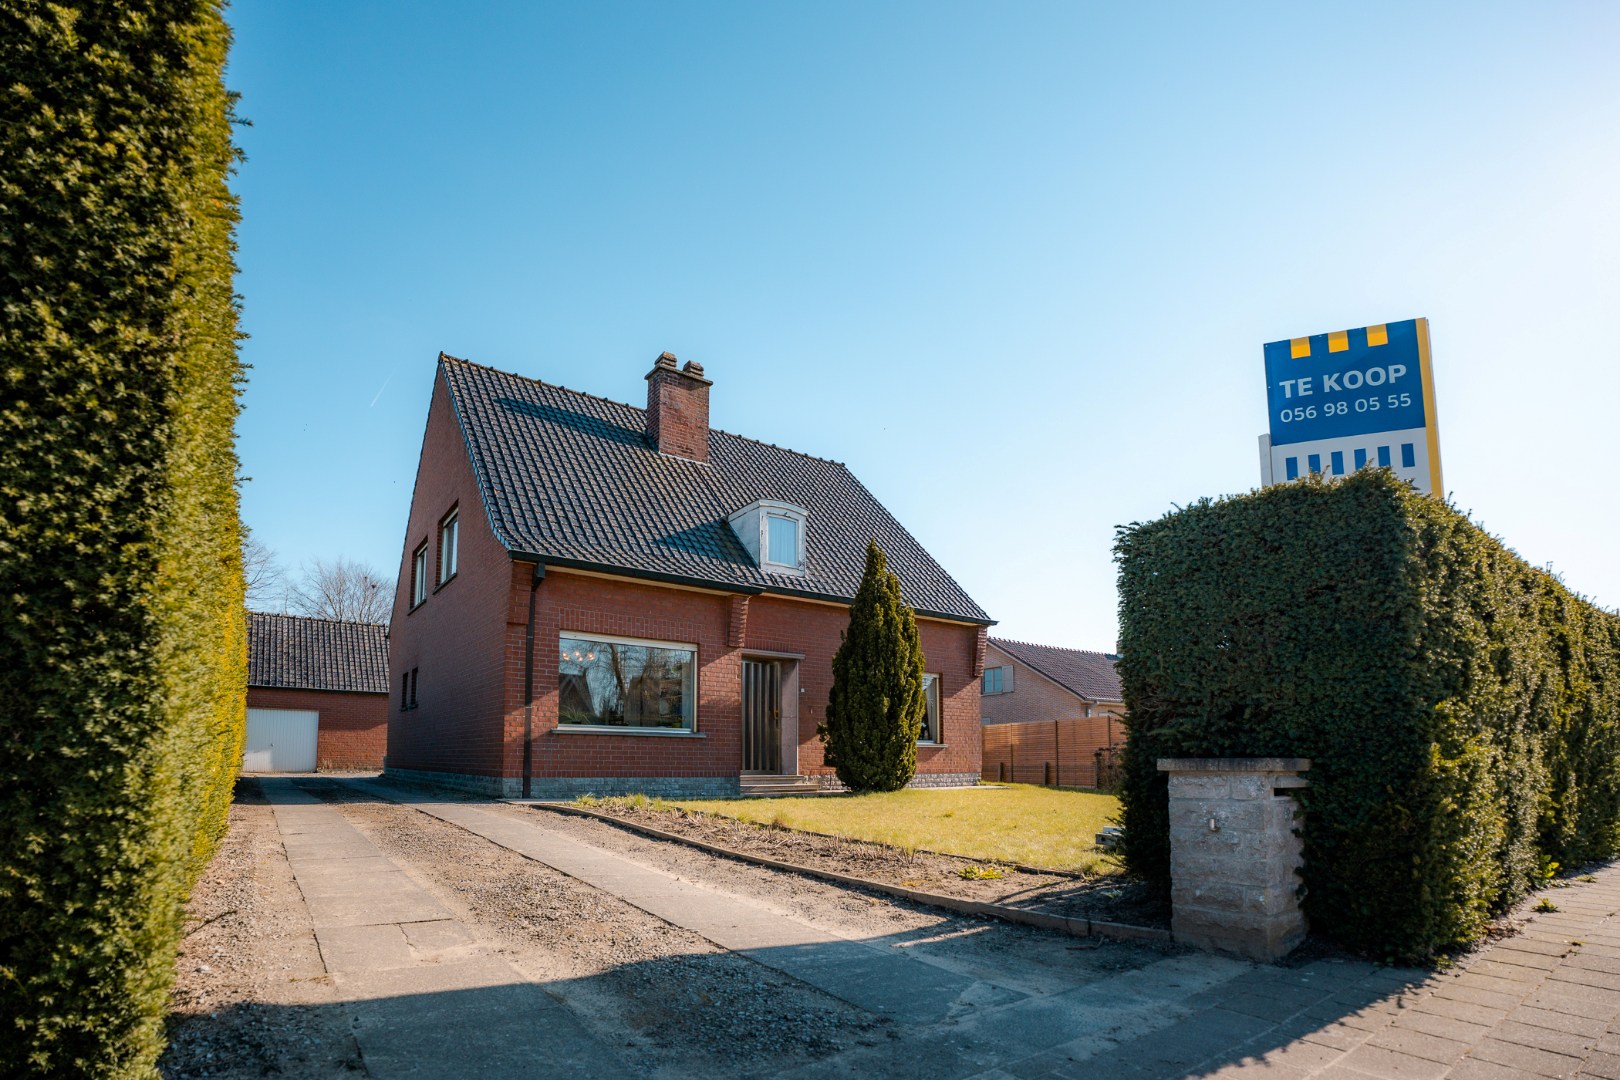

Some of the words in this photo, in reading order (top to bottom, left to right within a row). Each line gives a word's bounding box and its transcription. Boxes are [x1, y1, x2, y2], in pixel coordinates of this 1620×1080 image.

[1279, 377, 1313, 399] TE
[1323, 364, 1407, 393] KOOP
[1280, 406, 1317, 423] 056
[1323, 401, 1348, 417] 98
[1355, 397, 1380, 412] 05
[1387, 393, 1412, 409] 55
